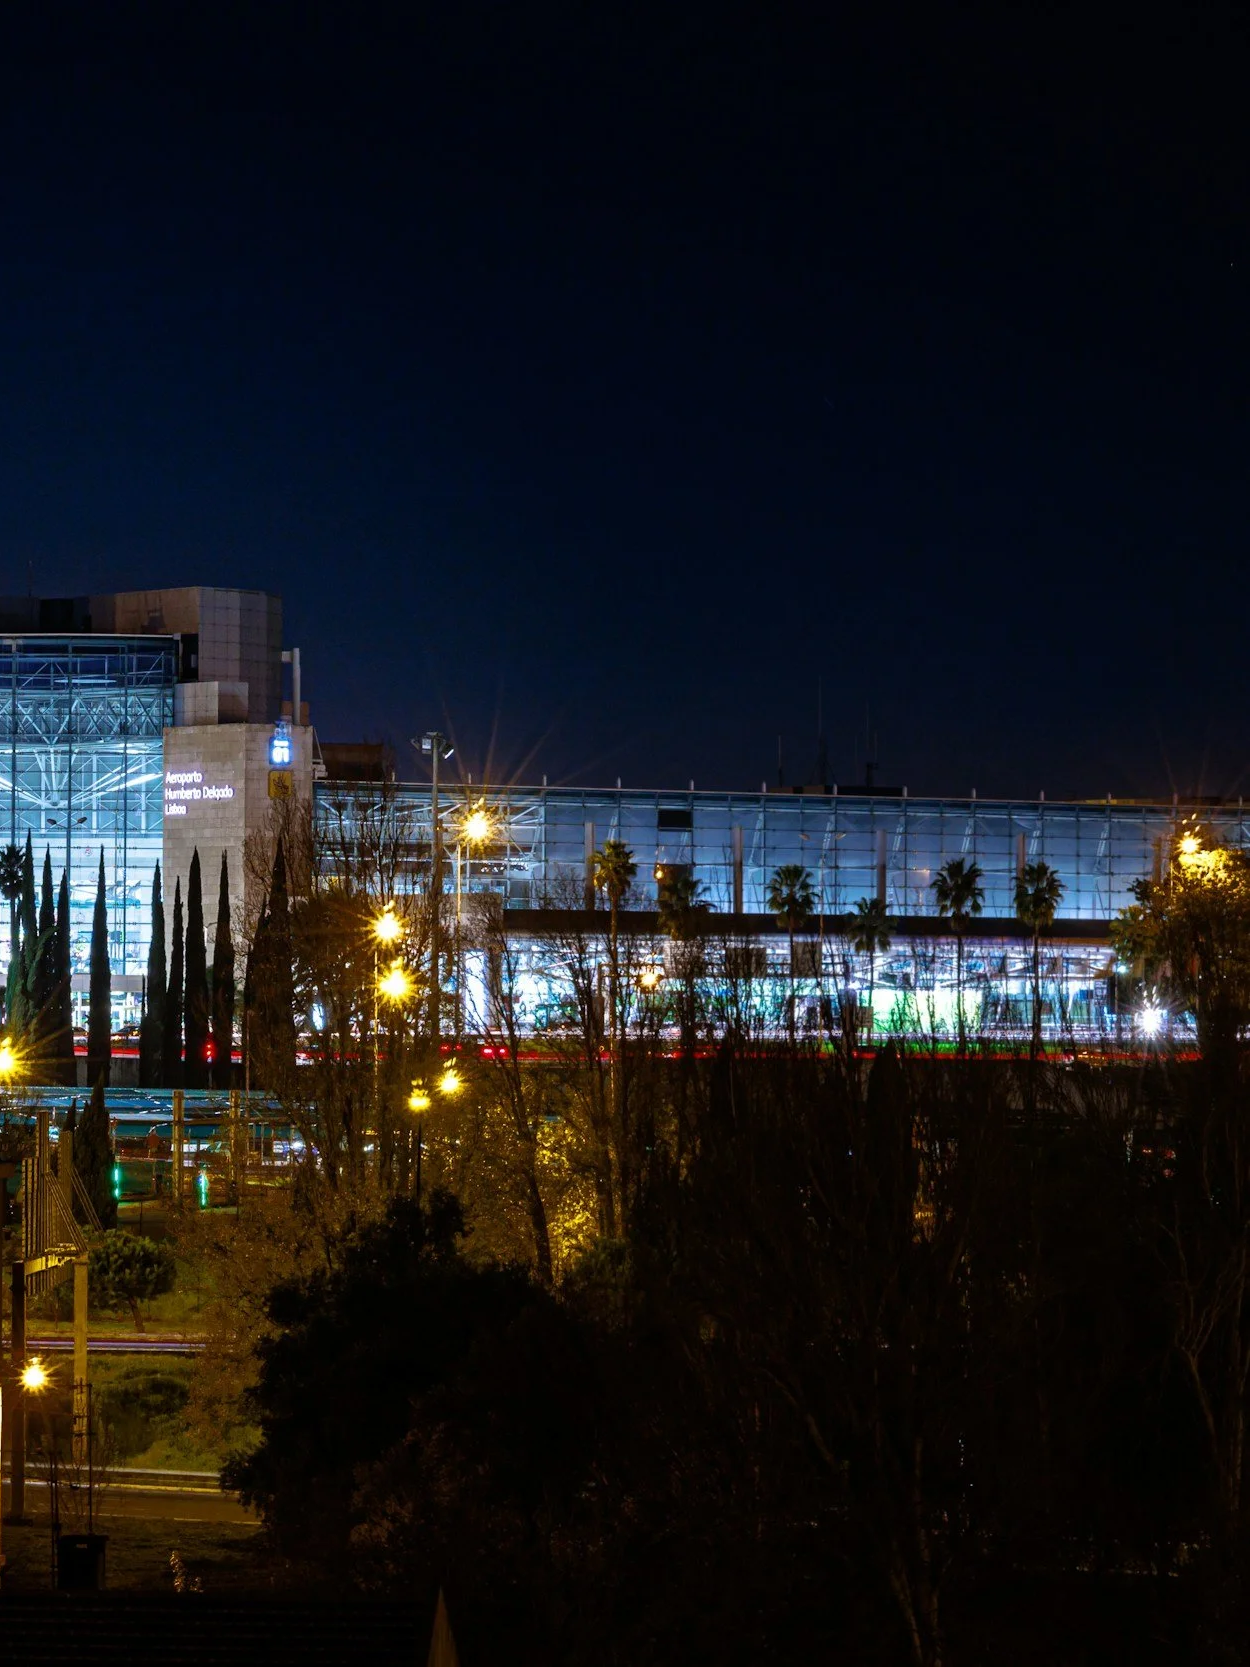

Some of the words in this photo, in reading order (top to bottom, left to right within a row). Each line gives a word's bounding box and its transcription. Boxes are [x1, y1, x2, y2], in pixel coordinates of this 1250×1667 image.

[165, 771, 203, 786] Aeroporto
[165, 787, 202, 800] Humberto
[202, 784, 234, 801] Delgado
[165, 803, 187, 815] Lisboa
